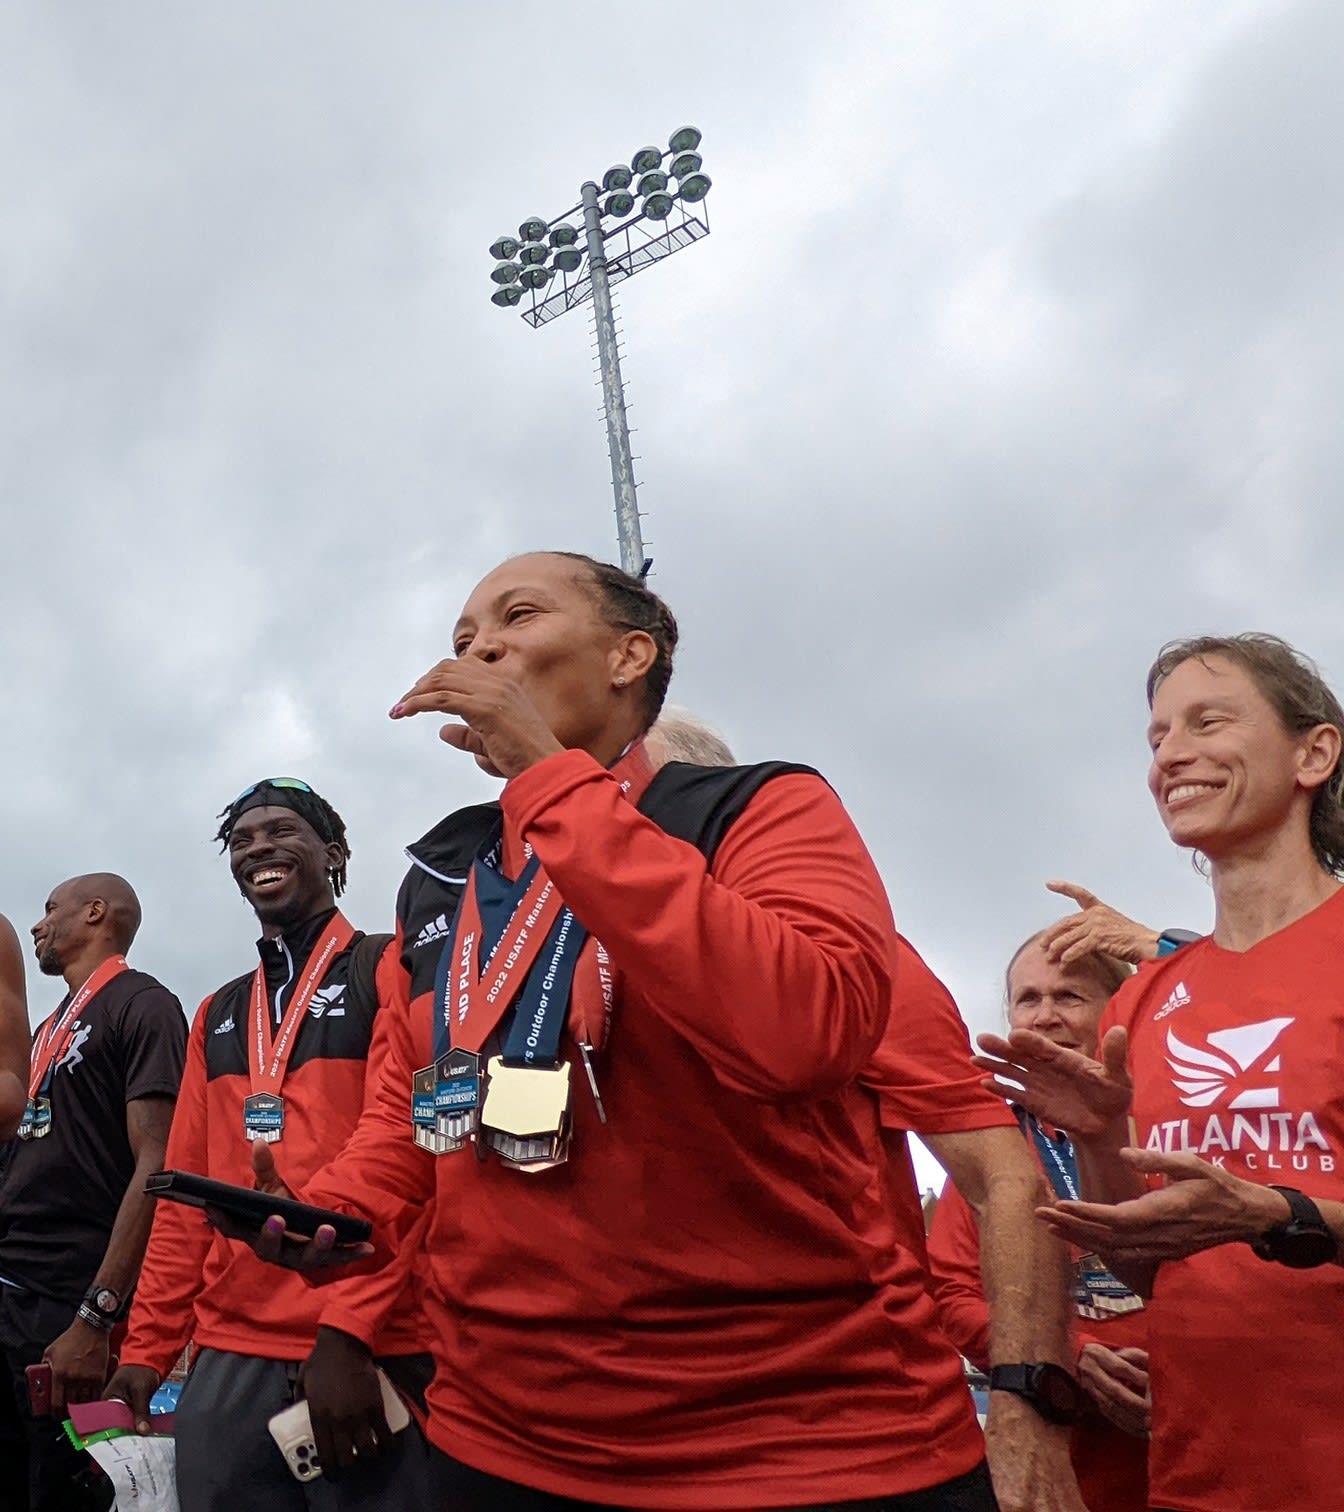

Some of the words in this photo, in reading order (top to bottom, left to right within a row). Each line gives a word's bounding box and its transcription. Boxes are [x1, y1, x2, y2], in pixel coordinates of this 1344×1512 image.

[459, 932, 475, 991] PLACE
[486, 971, 508, 1003] 2022
[505, 928, 529, 970] USATF
[527, 993, 550, 1047] Outdoor
[542, 908, 574, 990] Championsh
[71, 989, 92, 1013] PLACE
[276, 1034, 288, 1057] USATF
[285, 1007, 299, 1035] Masters
[297, 980, 312, 1007] Outdoor
[309, 936, 337, 980] Championships
[458, 993, 470, 1026] ND
[1153, 995, 1191, 1021] adidas
[436, 1091, 477, 1106] CHAMPIONSHIPS
[1146, 1111, 1331, 1154] ATLANTA
[1246, 1153, 1335, 1172] CLUB
